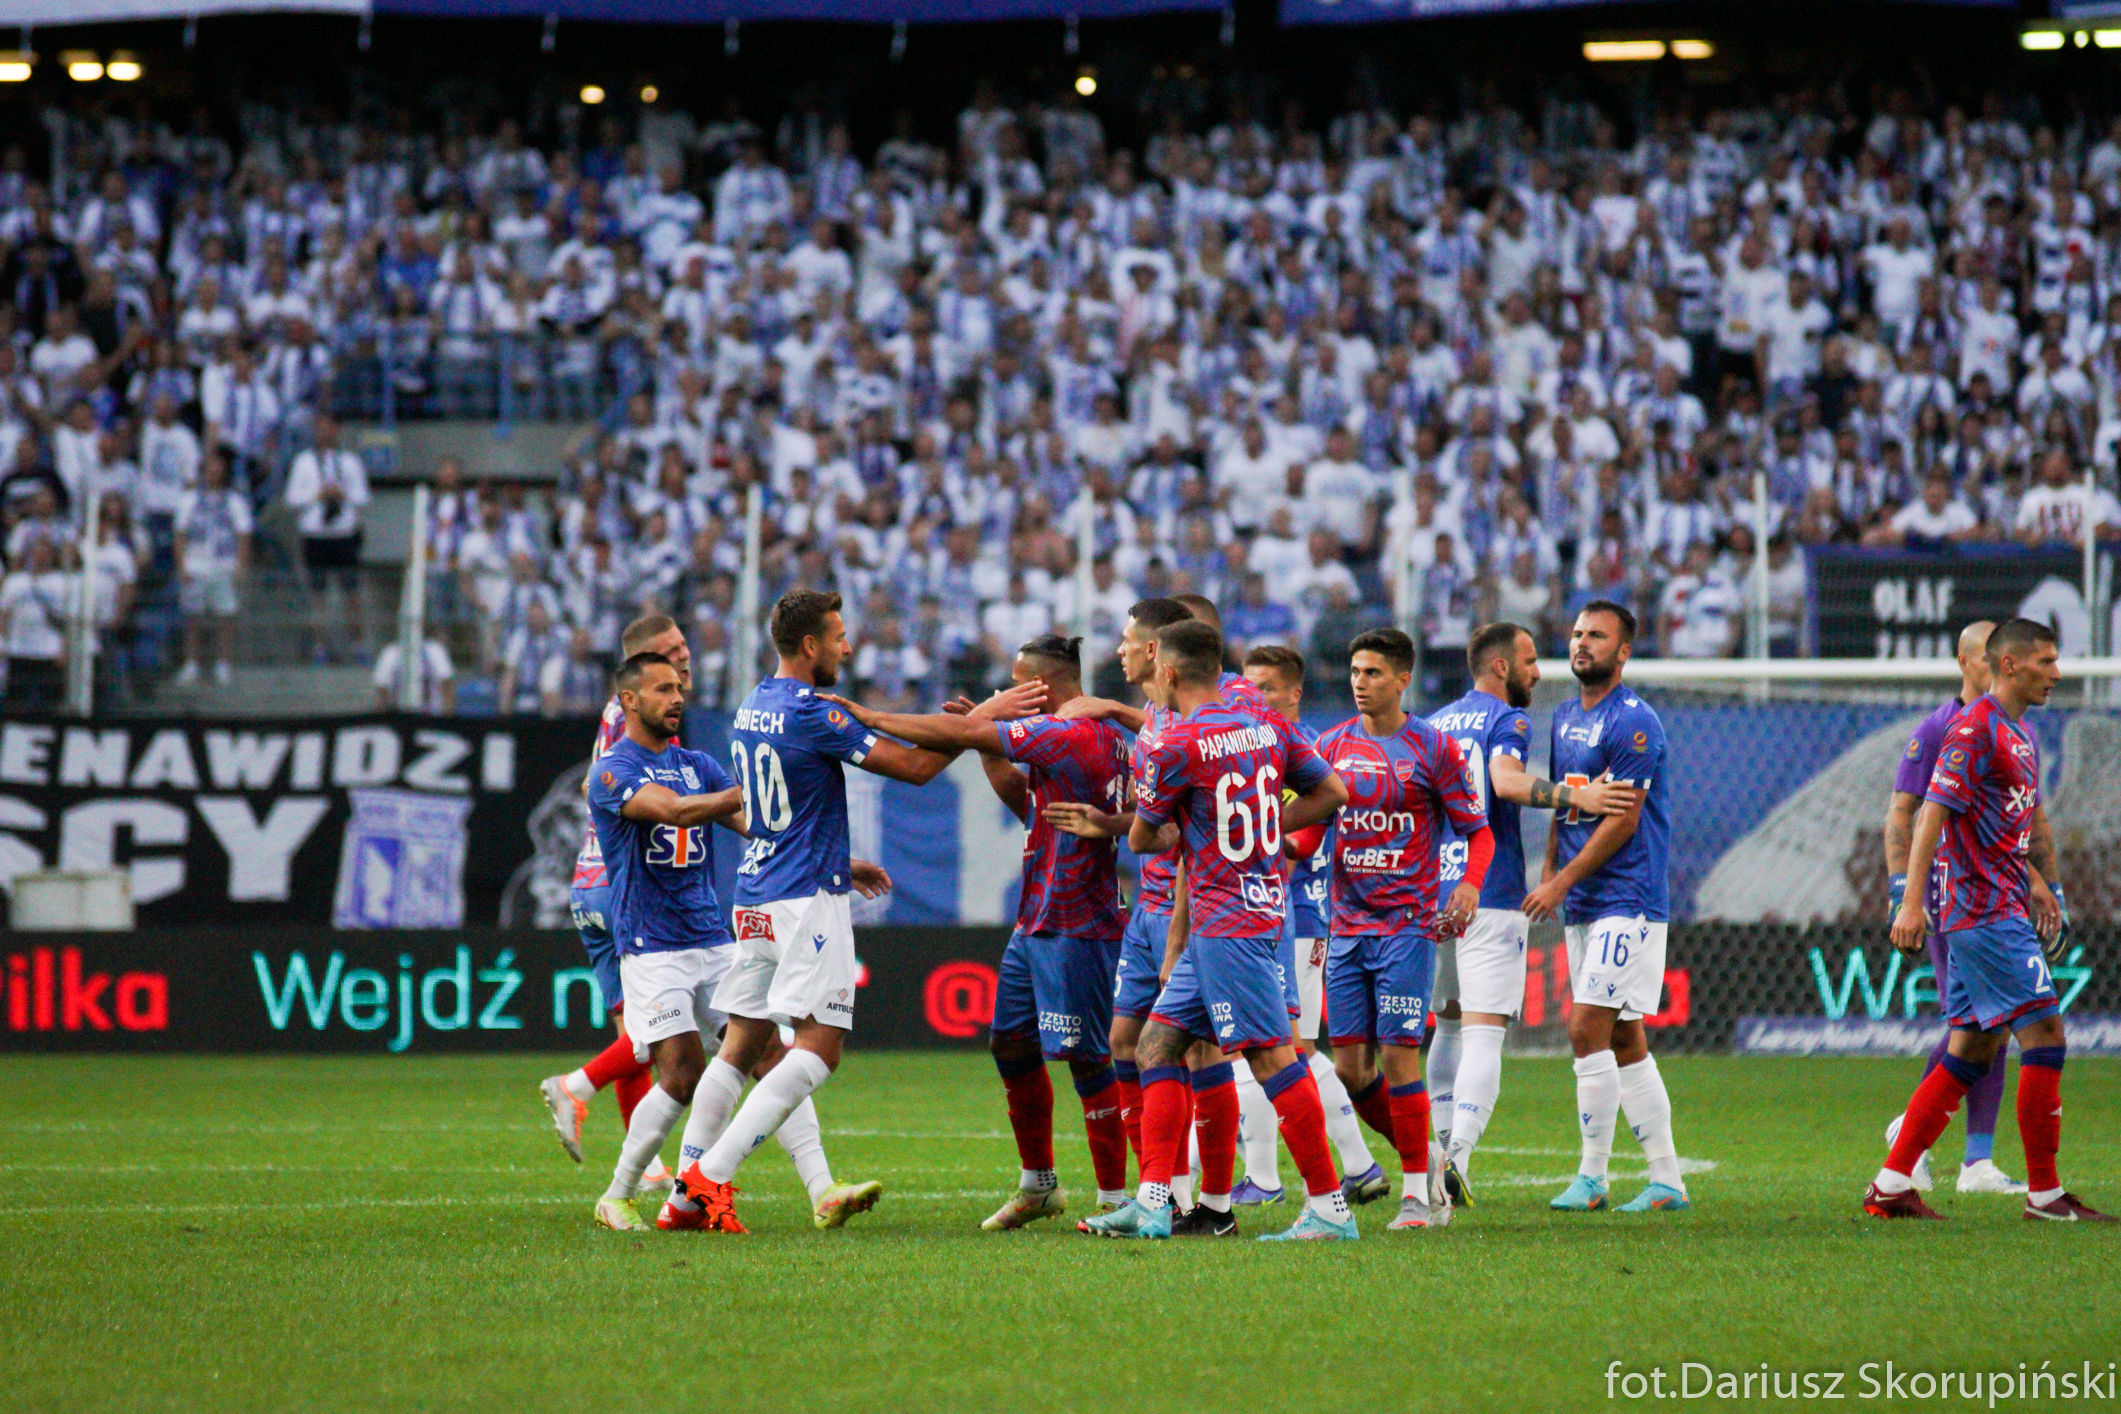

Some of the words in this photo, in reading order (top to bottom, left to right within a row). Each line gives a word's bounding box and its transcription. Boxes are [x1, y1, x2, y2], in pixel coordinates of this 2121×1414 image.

[1872, 575, 1954, 624] OLAF
[733, 708, 785, 735] OBIECH
[1197, 723, 1278, 762] PAPANIKOLAOU
[0, 721, 518, 792] ENAWIDZI
[1215, 764, 1281, 863] 66
[1342, 846, 1405, 869] forBET
[1599, 930, 1631, 968] 16
[0, 945, 169, 1032] ilka
[251, 943, 524, 1053] Wejdź
[648, 1007, 681, 1028] ARTBUD
